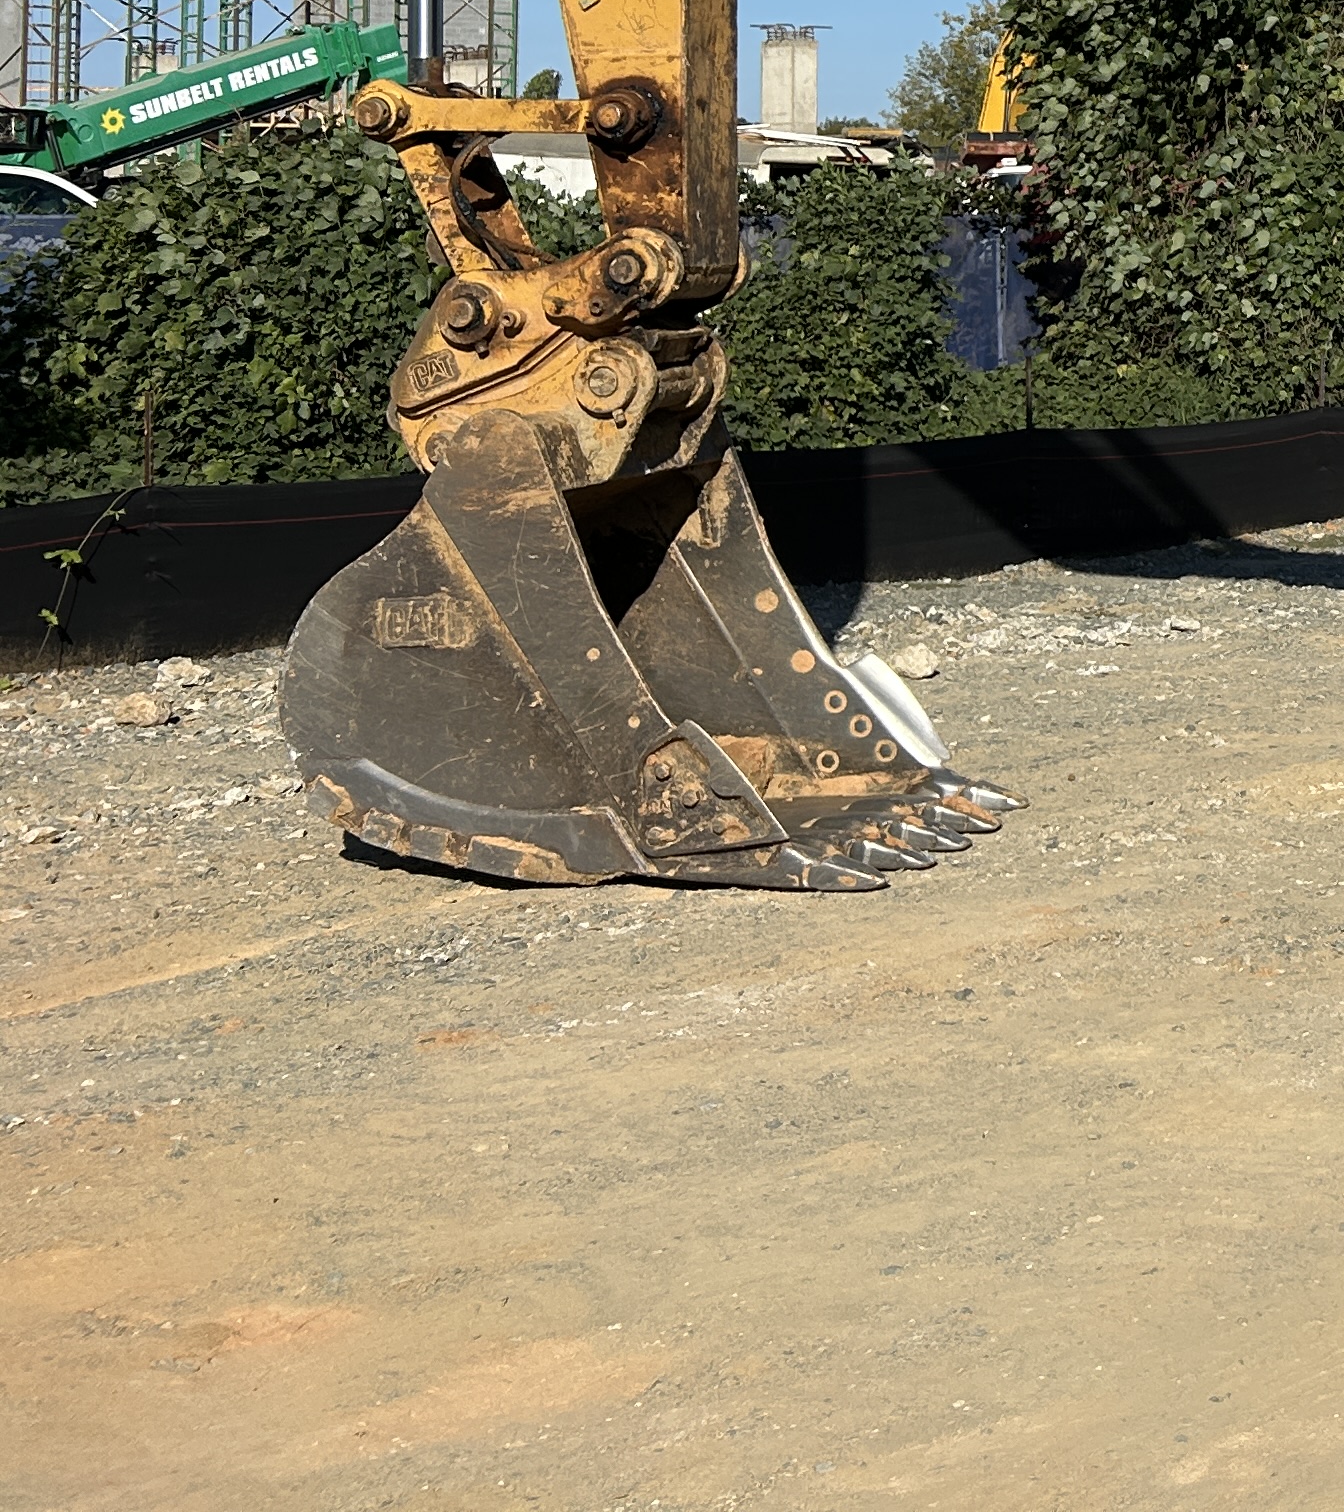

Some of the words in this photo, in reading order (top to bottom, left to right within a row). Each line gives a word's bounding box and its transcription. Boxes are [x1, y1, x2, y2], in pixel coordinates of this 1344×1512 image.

[129, 77, 223, 124] SUNBELT
[228, 47, 319, 92] RENTALS
[412, 354, 455, 390] CAT
